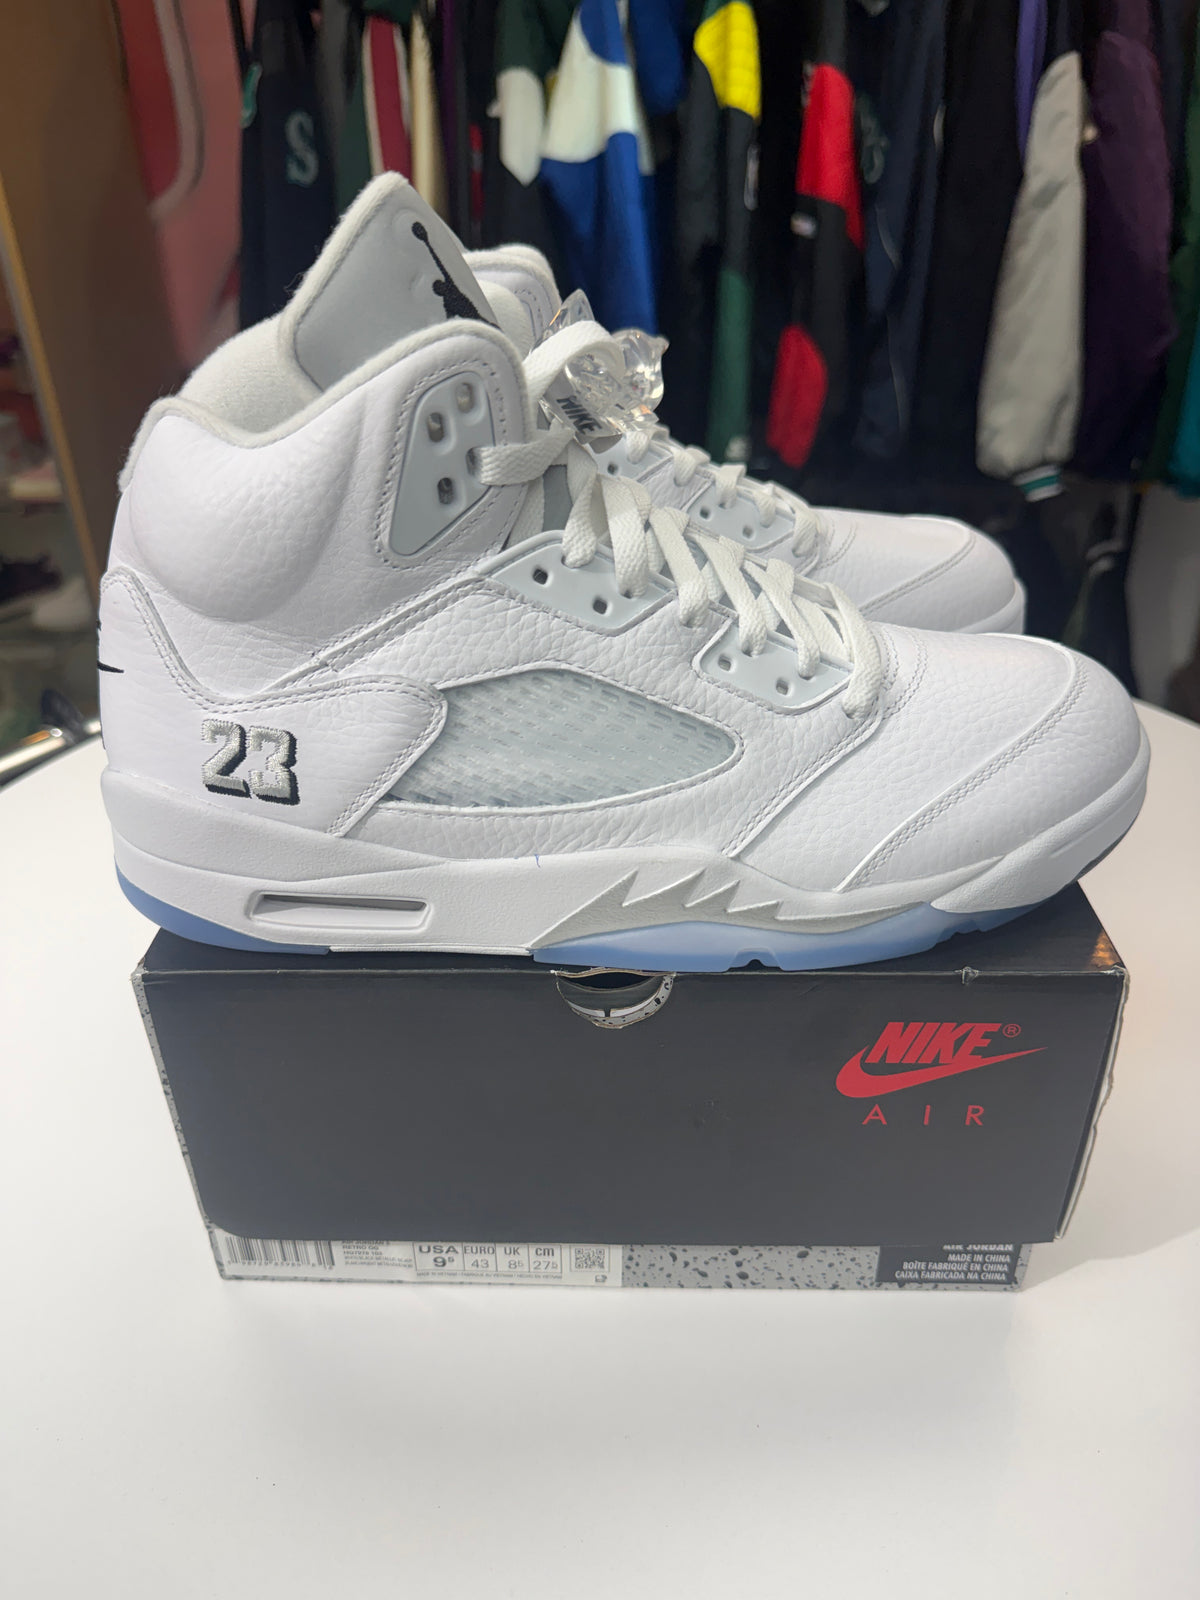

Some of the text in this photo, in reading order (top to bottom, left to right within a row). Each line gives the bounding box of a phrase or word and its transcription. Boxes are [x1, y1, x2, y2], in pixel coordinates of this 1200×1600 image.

[285, 109, 319, 186] S
[556, 395, 602, 435] NIKE
[201, 719, 300, 806] 23
[864, 1021, 1002, 1065] NIKE
[861, 1103, 985, 1126] AIR
[418, 1244, 555, 1257] USA EURO UK cm
[947, 1253, 1011, 1263] MADE IN CHINA
[471, 1258, 489, 1269] 43
[969, 1262, 981, 1271] EN
[982, 1262, 1008, 1272] CHINA
[894, 1270, 1006, 1281] CAIXA FABRICADA NA CHINA
